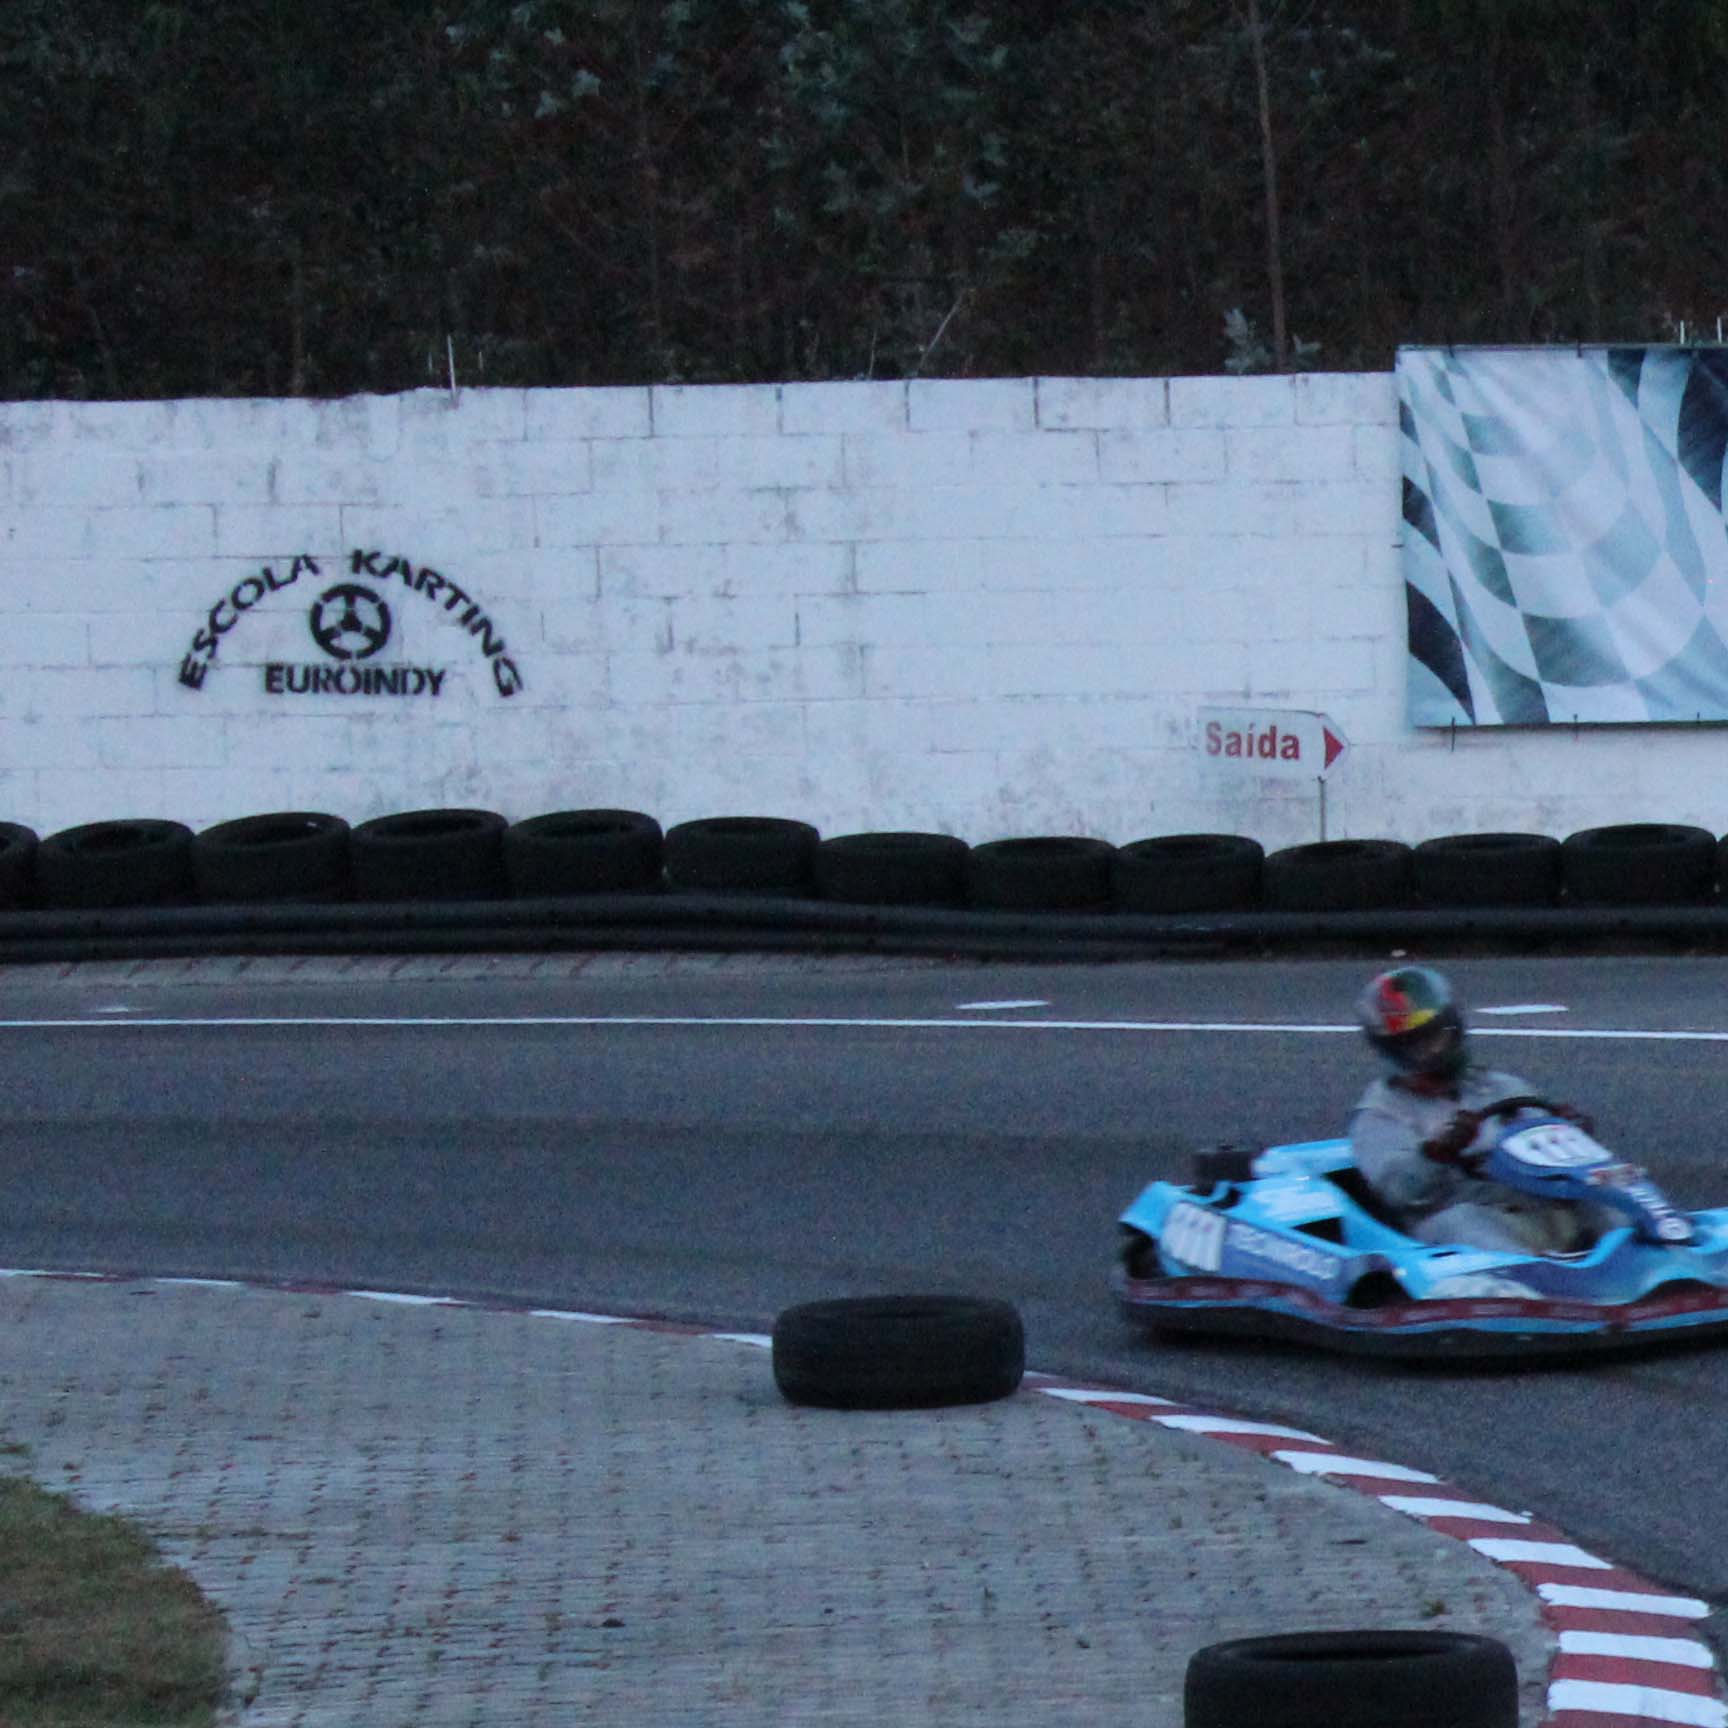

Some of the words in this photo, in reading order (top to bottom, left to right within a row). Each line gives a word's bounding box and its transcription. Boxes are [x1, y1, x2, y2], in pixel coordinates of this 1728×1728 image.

[177, 553, 321, 692] ESCOLA
[351, 548, 524, 698] KARTING
[264, 662, 447, 696] EUROINDY
[1205, 720, 1300, 760] Saída
